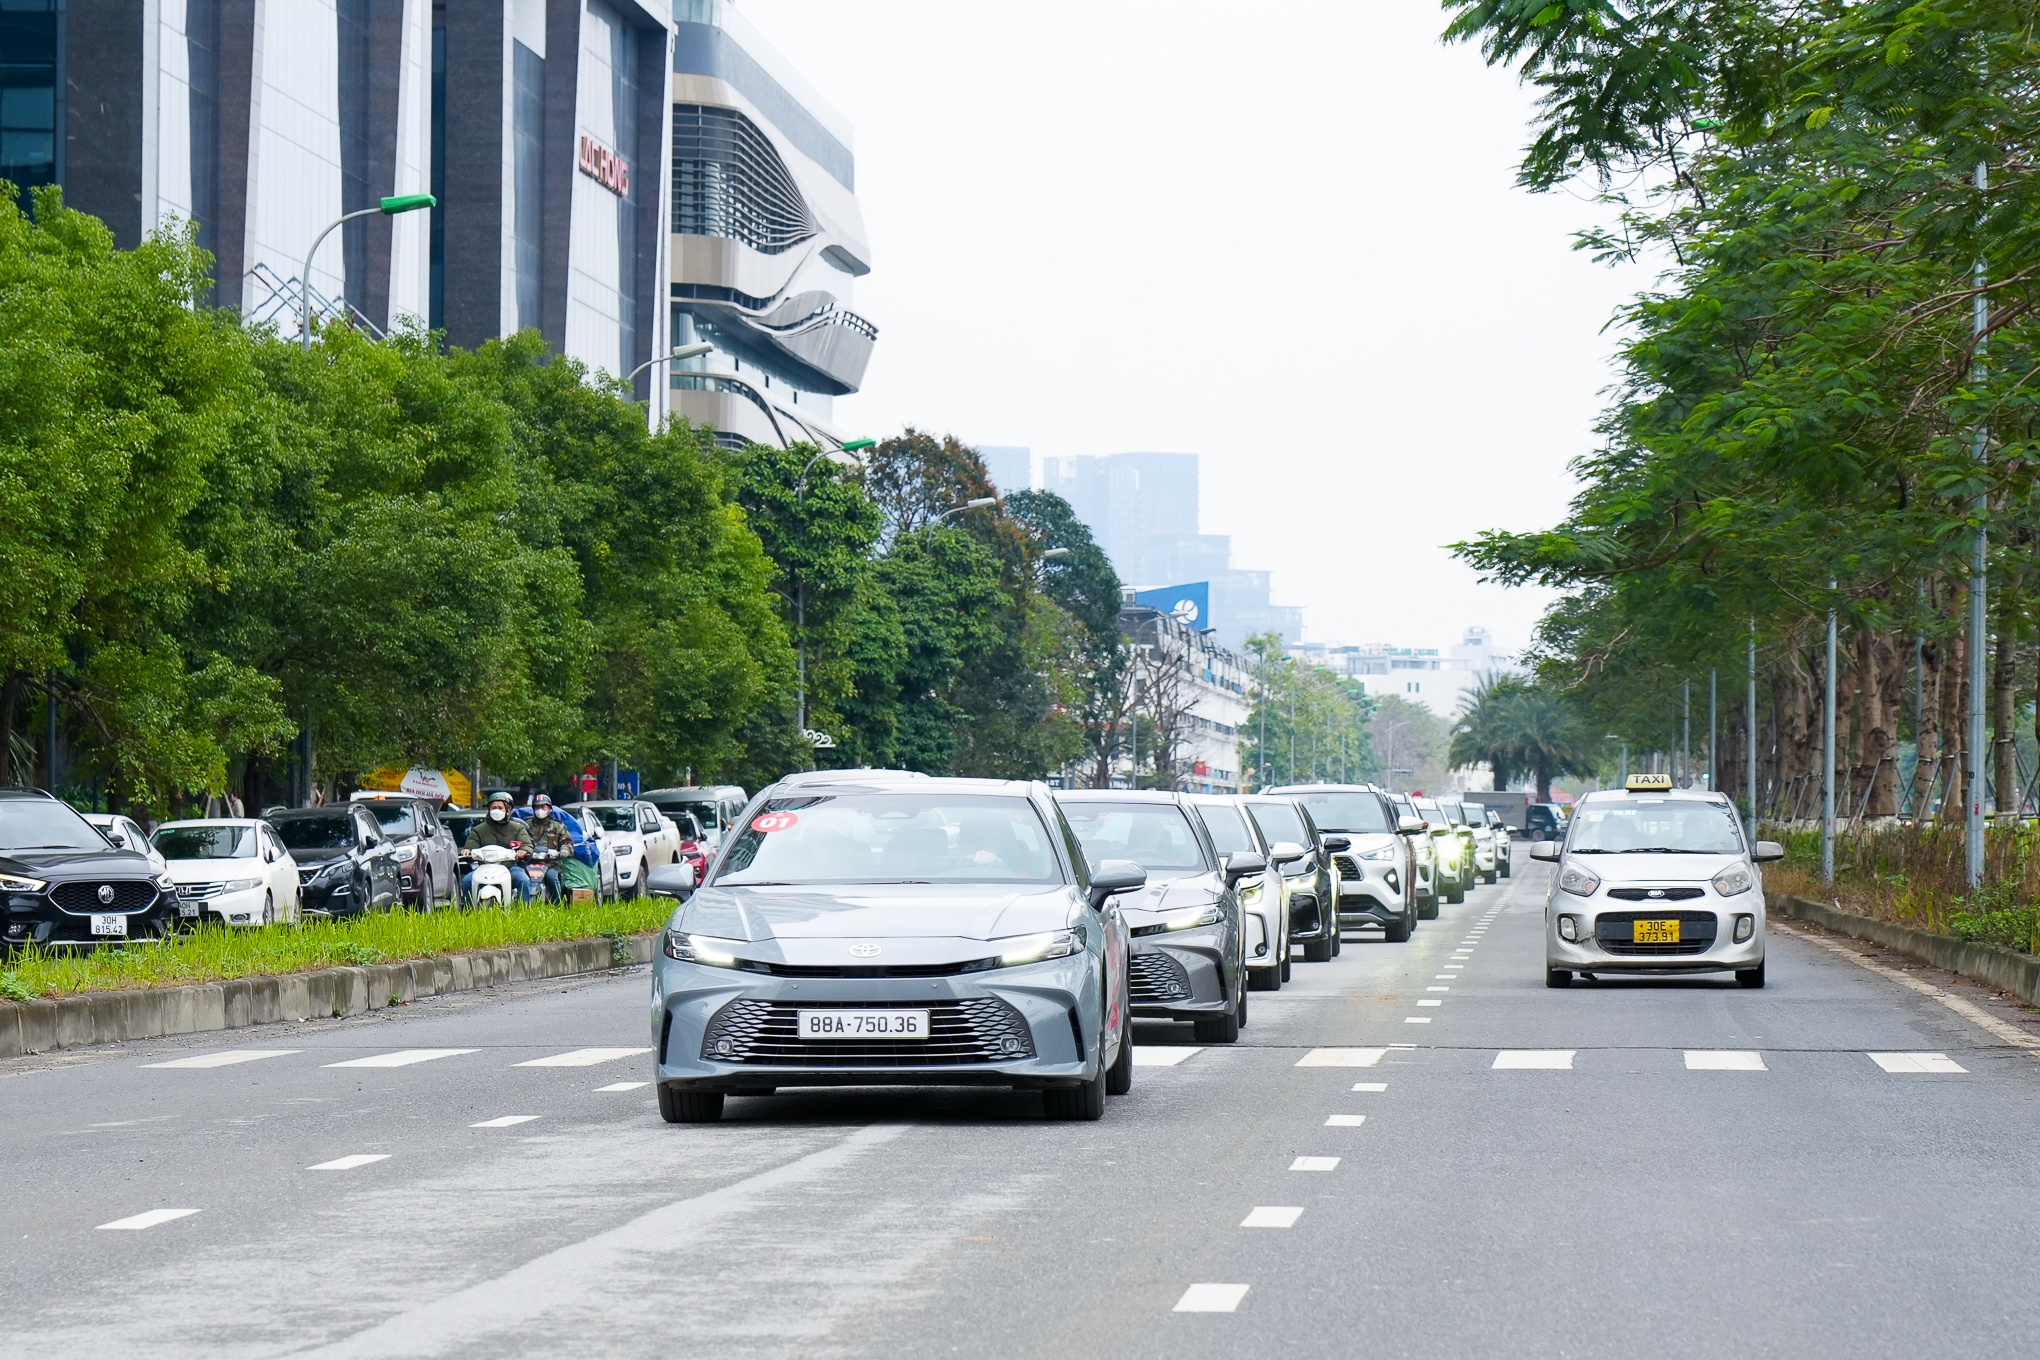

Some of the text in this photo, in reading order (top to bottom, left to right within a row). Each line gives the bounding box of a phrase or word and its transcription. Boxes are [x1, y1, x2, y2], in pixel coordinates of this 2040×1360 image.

[1633, 775, 1665, 784] TAXI
[759, 817, 790, 828] 01
[99, 886, 114, 902] MG
[101, 916, 117, 925] 30H
[95, 925, 123, 934] 815.42
[1646, 921, 1667, 931] 30E
[1638, 932, 1674, 942] 373.91
[810, 1016, 918, 1033] 88A-750.36
